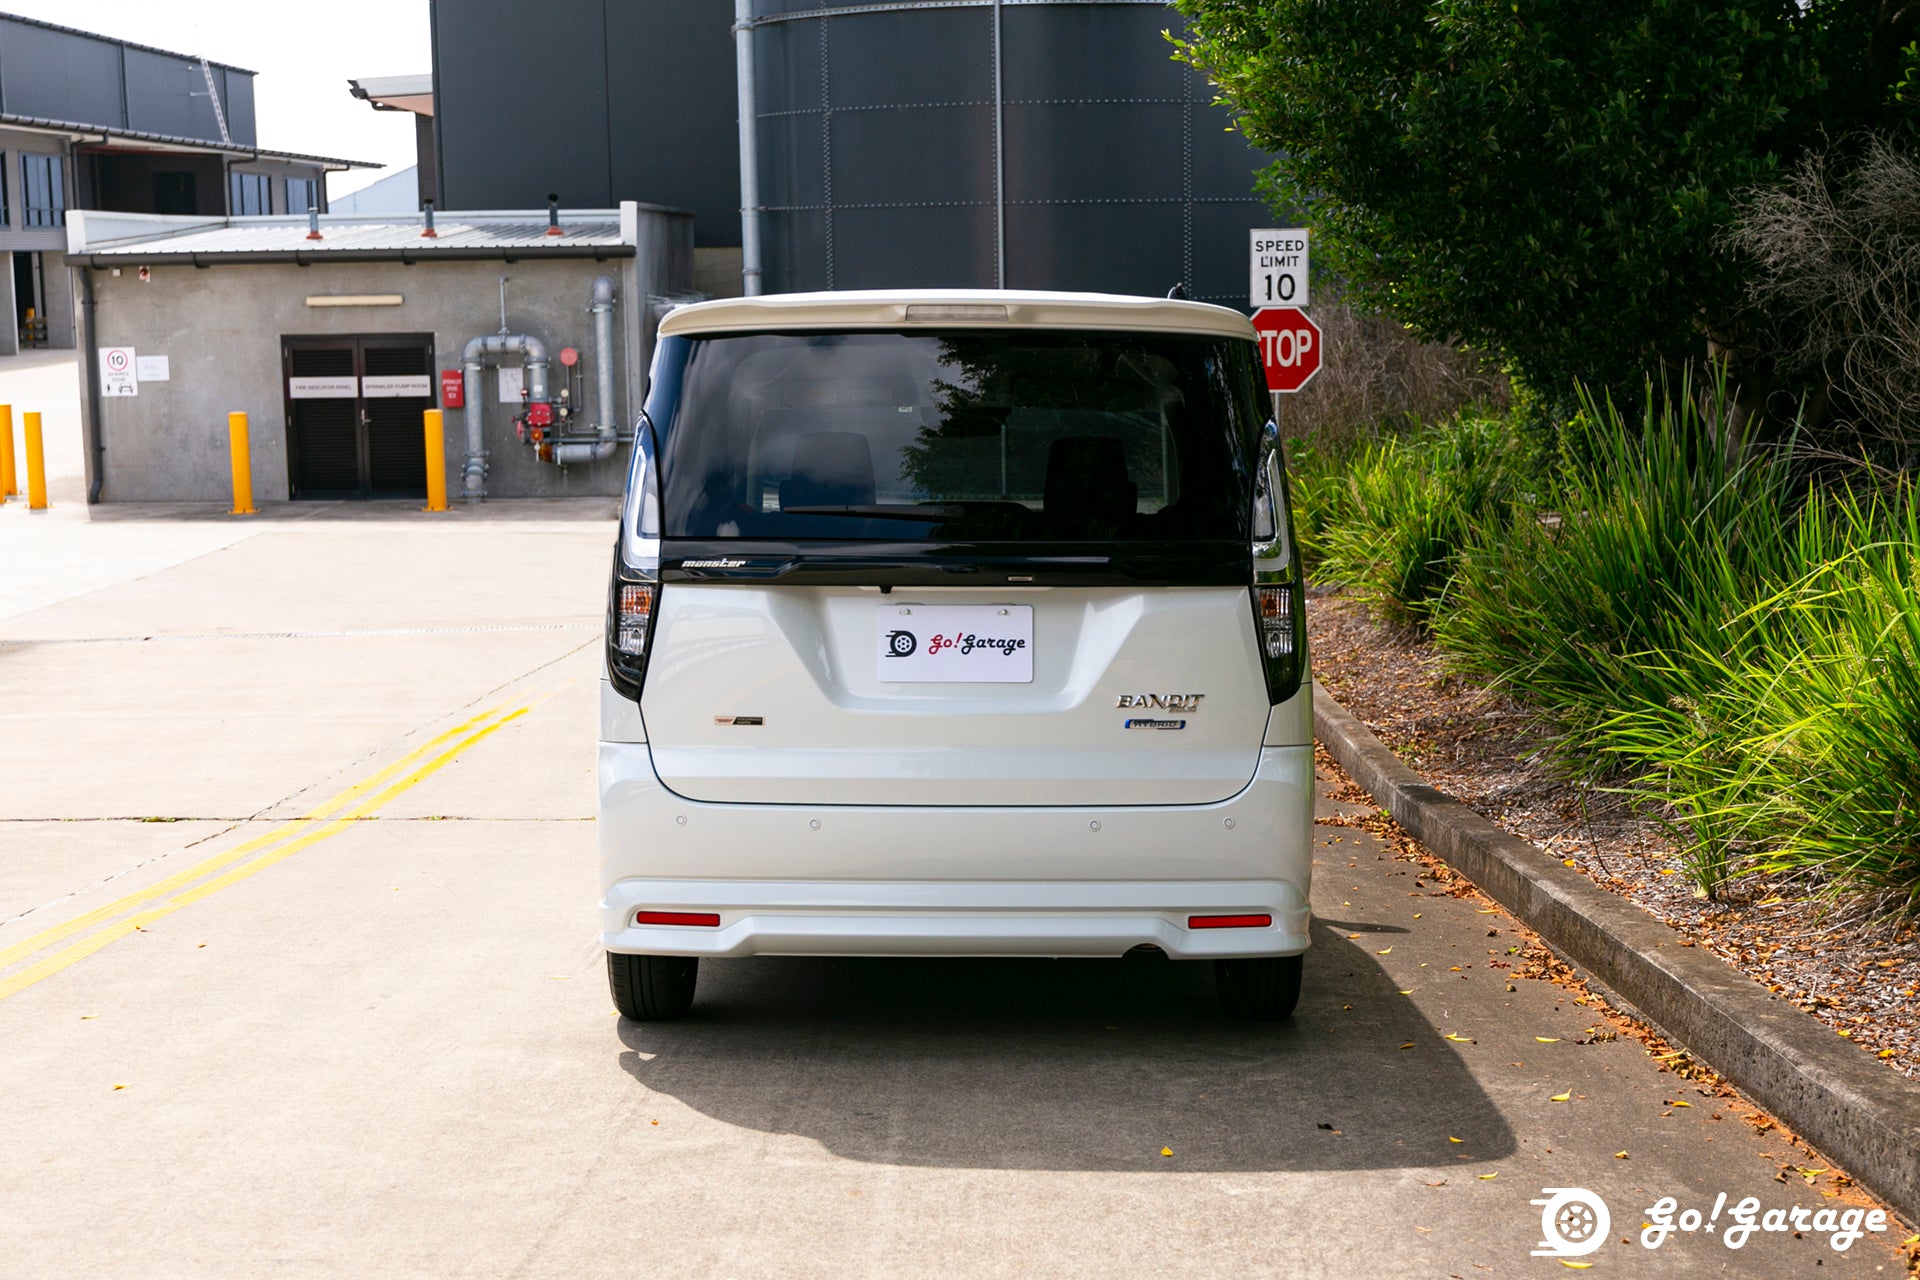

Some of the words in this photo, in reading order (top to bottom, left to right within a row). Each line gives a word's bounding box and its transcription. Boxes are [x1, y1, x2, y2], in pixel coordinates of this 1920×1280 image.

[1255, 240, 1305, 252] SPEED
[1260, 256, 1300, 267] LIMIT
[1264, 273, 1296, 301] 10
[1256, 328, 1313, 368] TOP
[111, 355, 124, 366] 10
[681, 557, 747, 568] monster
[1116, 694, 1205, 709] BANDIT
[1134, 719, 1178, 728] HYBRID
